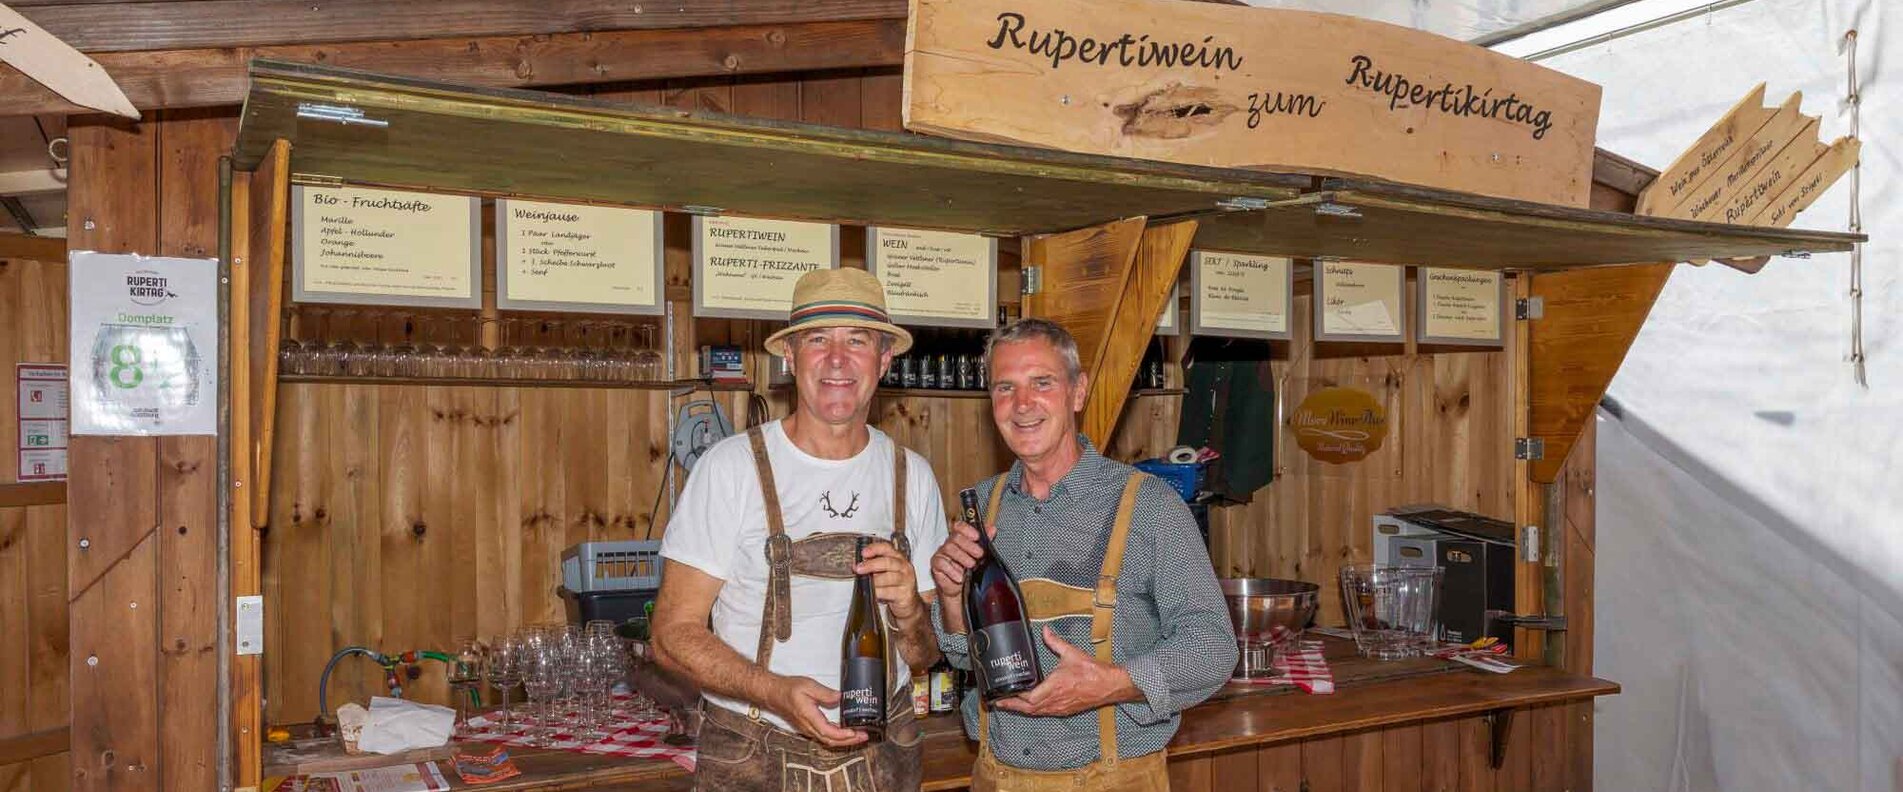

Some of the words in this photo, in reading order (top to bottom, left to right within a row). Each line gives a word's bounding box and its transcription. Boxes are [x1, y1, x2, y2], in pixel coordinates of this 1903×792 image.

[987, 12, 1243, 71] Rupertiwein
[1345, 55, 1553, 139] Rupertikirtag
[1247, 89, 1326, 129] zum
[1725, 169, 1781, 224] Rupertiwein
[313, 193, 338, 206] Bio
[352, 196, 432, 214] Fruchtsäfte
[321, 216, 353, 225] Marille
[514, 208, 580, 224] Weinjause
[320, 227, 342, 236] Apfel
[528, 230, 548, 238] Paar
[709, 227, 786, 242] RUPERTIWEIN
[320, 238, 355, 248] Orange
[882, 239, 908, 250] WEIN
[320, 249, 384, 260] Johannisbeere
[531, 268, 548, 277] Senf
[127, 276, 167, 288] RUPERTI
[130, 287, 165, 298] KIRTAG
[118, 312, 175, 324] Domplatz
[990, 651, 1022, 669] ruperti
[1007, 659, 1029, 674] wein
[843, 687, 873, 700] ruperti
[855, 695, 878, 707] wein
